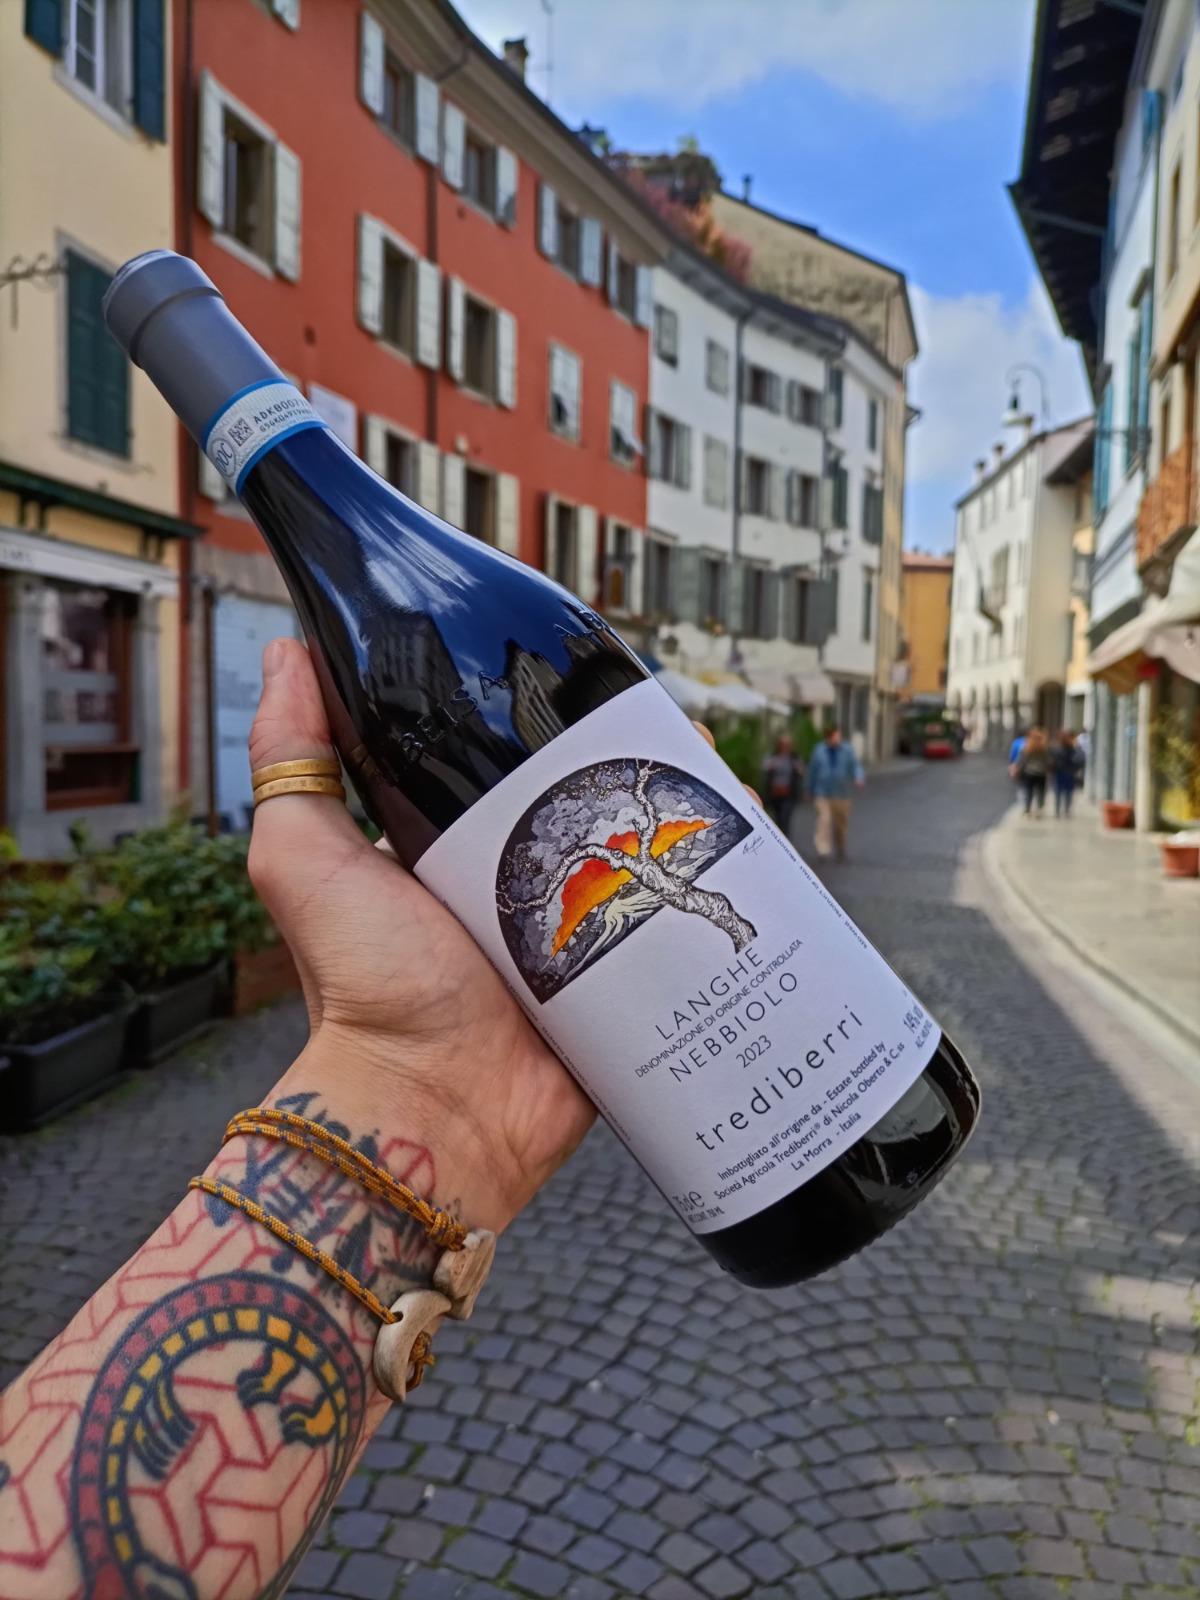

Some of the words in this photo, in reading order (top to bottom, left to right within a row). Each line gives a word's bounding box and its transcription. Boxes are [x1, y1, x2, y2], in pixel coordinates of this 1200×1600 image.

[635, 1022, 706, 1078] DENOMINAZIONE
[703, 1014, 717, 1027] DI
[715, 985, 752, 1018] ORIGINE
[750, 939, 803, 988] CONTROLLATA
[655, 947, 763, 1040] LANGHE
[668, 972, 797, 1082] NEBBIOLO
[736, 1034, 772, 1068] 2023
[696, 1004, 863, 1151] trediberri
[713, 1181, 743, 1200] Società
[742, 1161, 777, 1186] Agricola
[823, 1115, 833, 1126] di
[830, 1092, 860, 1119] Nicola
[857, 1065, 886, 1093] Oberto
[884, 1057, 892, 1068] &
[717, 1146, 769, 1180] Imbottigliato
[770, 1113, 811, 1148] all'origine
[811, 1105, 822, 1116] da
[826, 1076, 853, 1101] Estate
[850, 1049, 878, 1078] bottled
[874, 1041, 887, 1054] by
[790, 1159, 805, 1171] La
[803, 1137, 832, 1162] Morra
[839, 1111, 861, 1132] Italia
